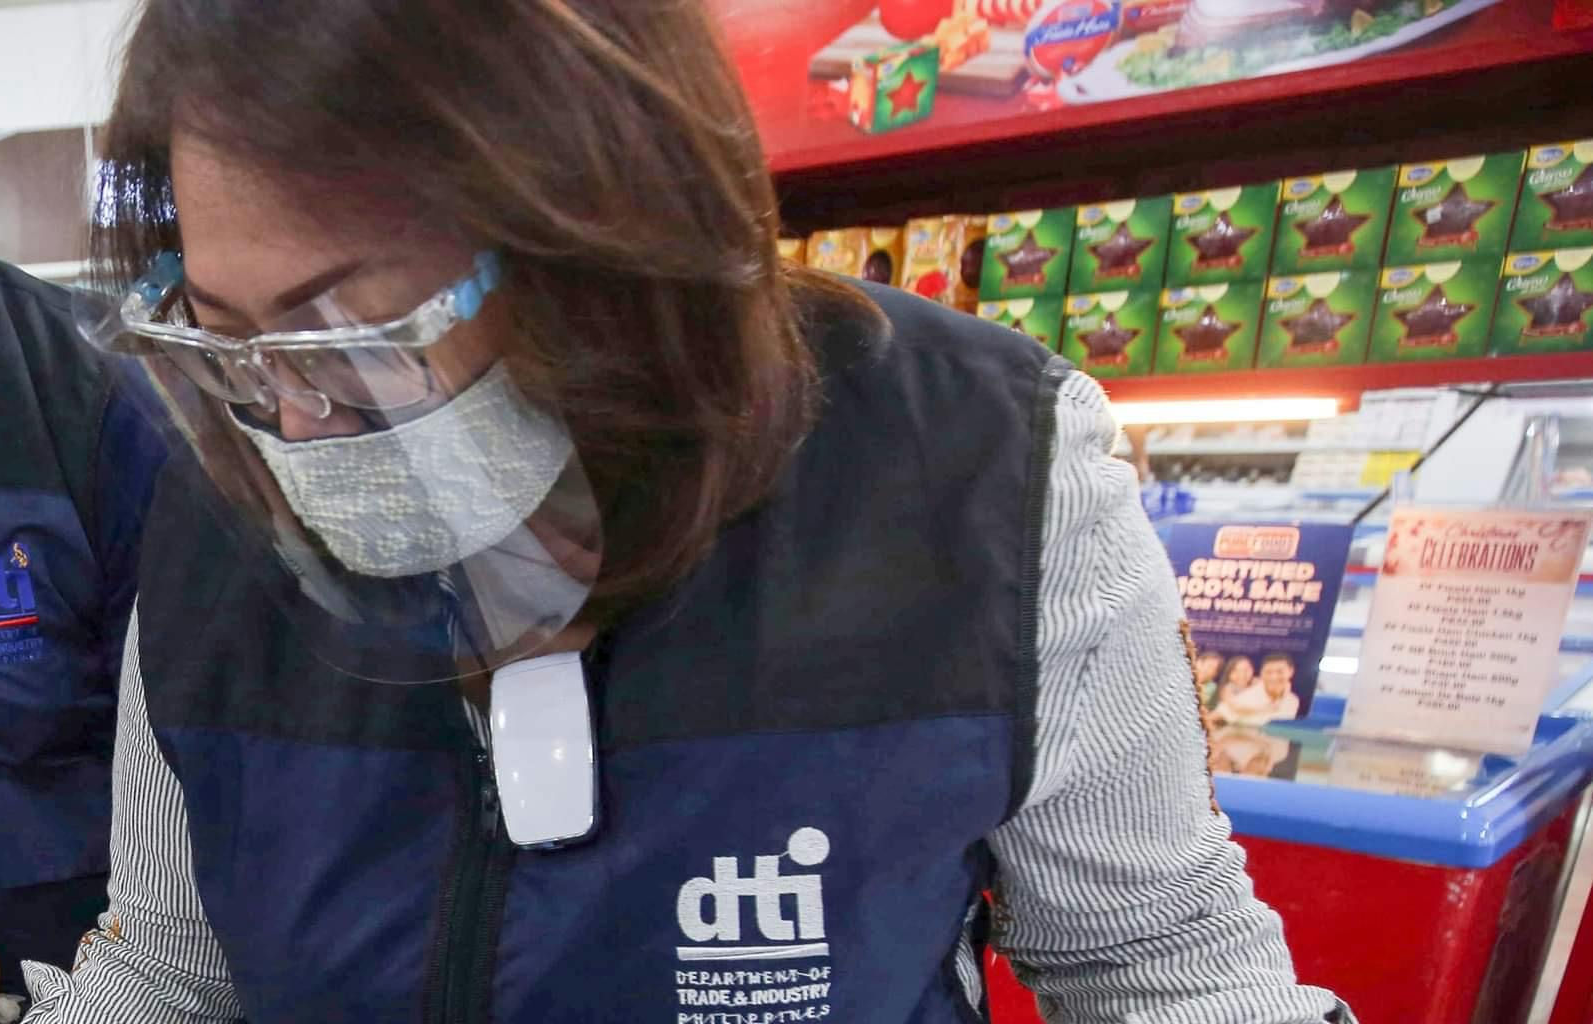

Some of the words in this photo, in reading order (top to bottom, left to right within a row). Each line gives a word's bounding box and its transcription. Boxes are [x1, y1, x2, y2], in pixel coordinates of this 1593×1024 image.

[1420, 537, 1539, 571] CELEBRATIONS
[1189, 558, 1315, 581] CERTIFIED
[1248, 578, 1323, 602] SAFE
[1253, 600, 1305, 615] FAMILY
[676, 827, 831, 942] dti
[676, 969, 799, 986] DEPARTMENT
[810, 966, 832, 982] OF
[677, 989, 731, 1006] TRADE
[733, 991, 748, 1007] &
[751, 982, 832, 1005] INDUSTRY
